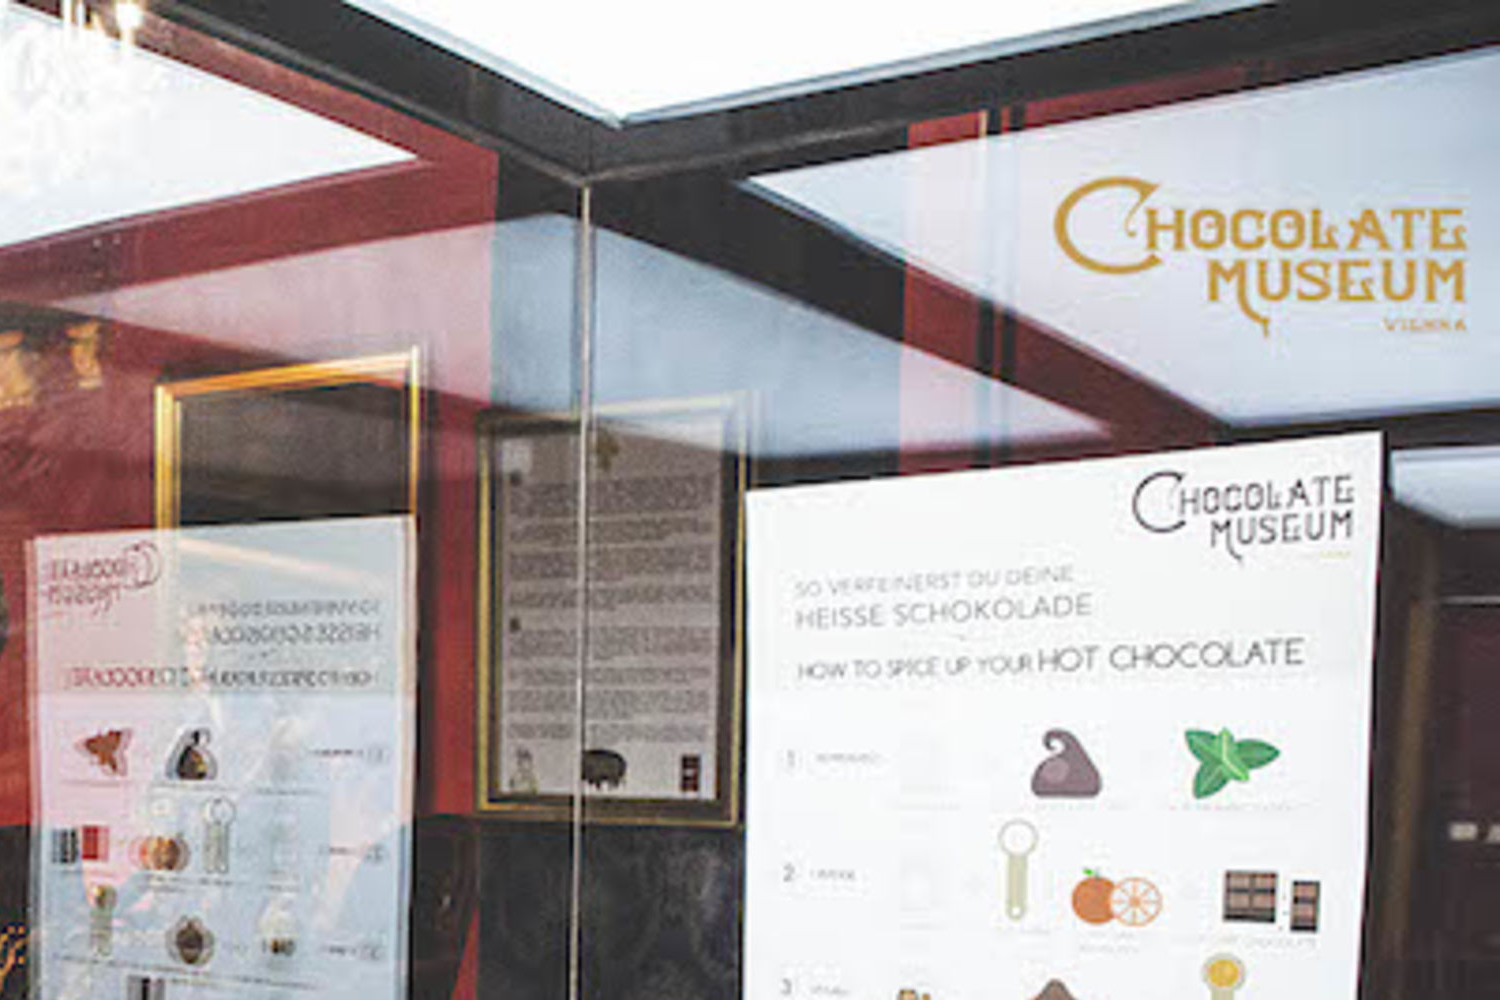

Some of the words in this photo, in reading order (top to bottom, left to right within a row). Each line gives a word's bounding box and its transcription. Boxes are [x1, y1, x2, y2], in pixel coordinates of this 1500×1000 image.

[1132, 470, 1355, 534] CHOCOLATE
[1210, 510, 1353, 562] MUSEUM
[795, 579, 822, 598] SO
[827, 571, 961, 596] VERFEINERST
[795, 603, 885, 630] HEISSE
[893, 592, 1093, 627] SCHOKOLADE
[798, 661, 848, 680] HOW
[853, 659, 882, 677] TO
[887, 656, 939, 679] SPICE
[944, 655, 971, 675] UP
[978, 652, 1033, 675] YOUR
[1037, 645, 1101, 673] HOT
[1109, 637, 1305, 670] CHOCOLATE
[783, 862, 796, 882] 2
